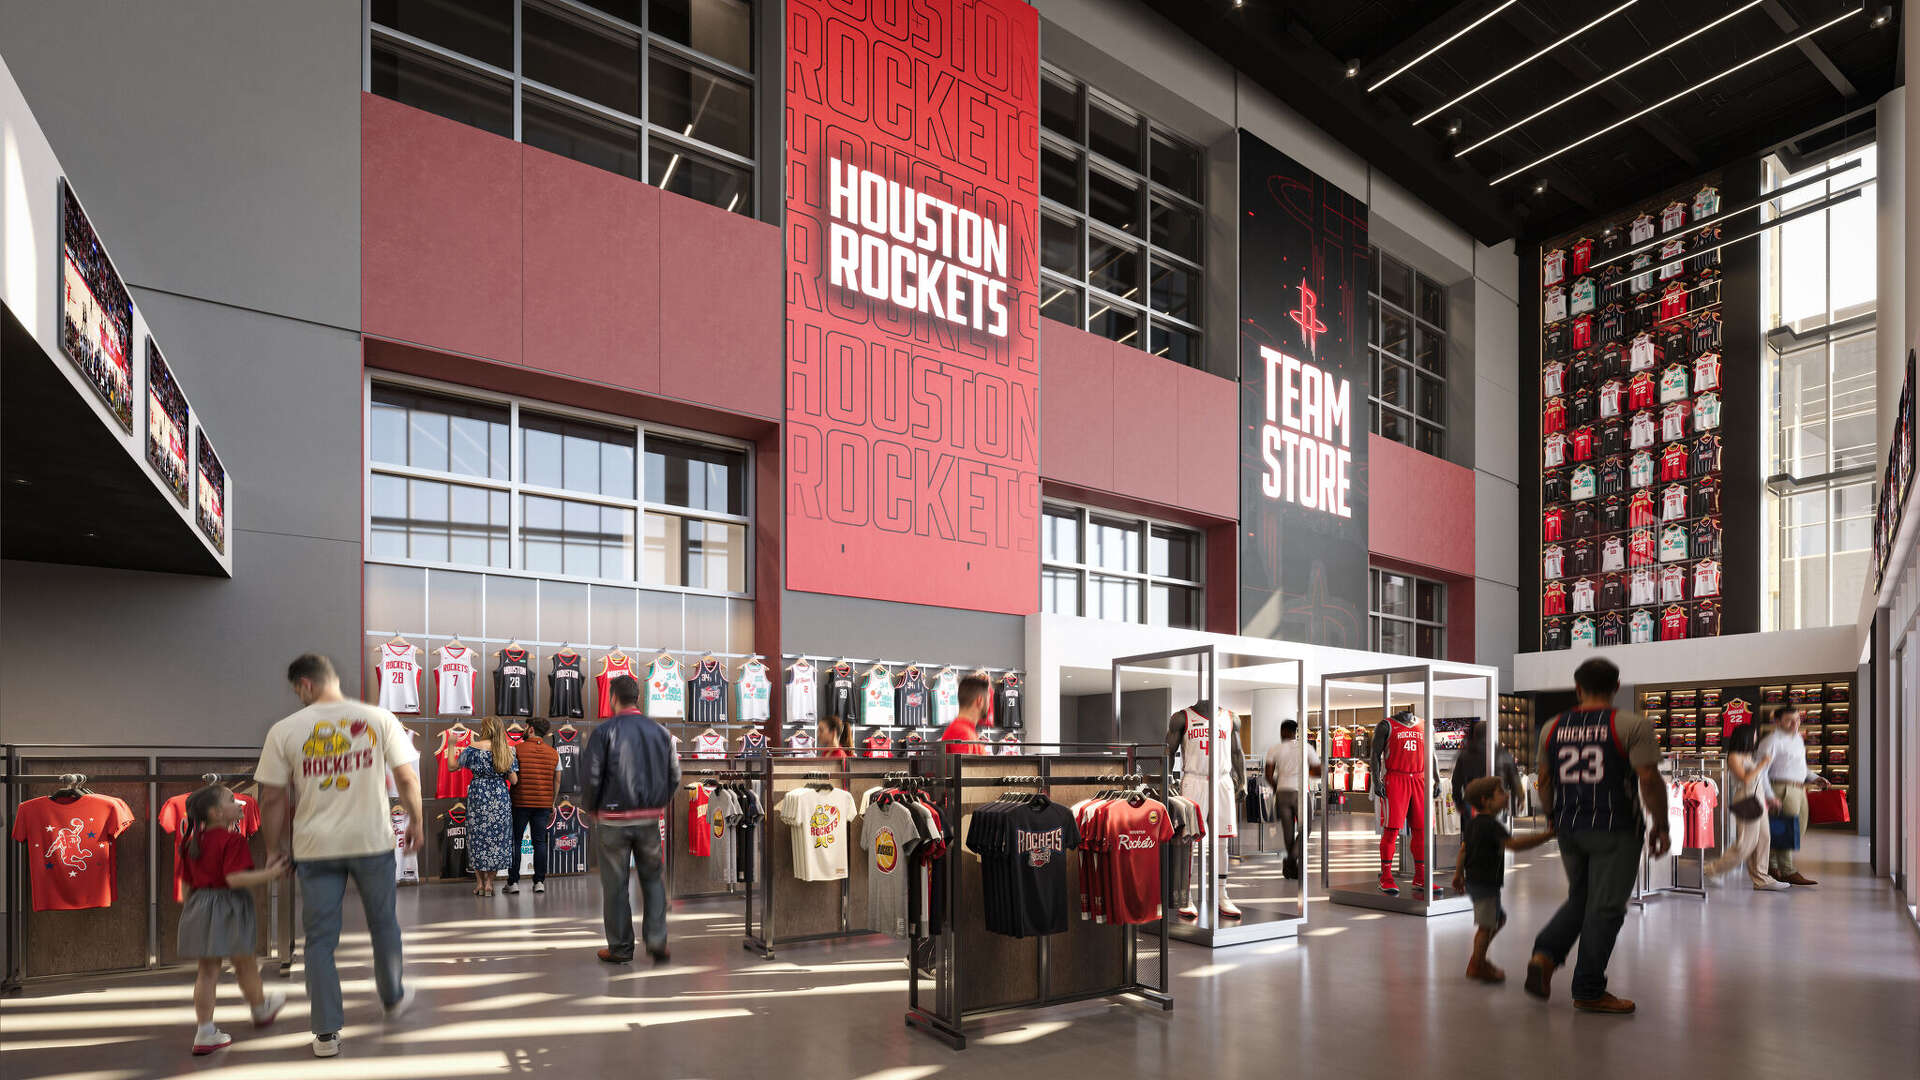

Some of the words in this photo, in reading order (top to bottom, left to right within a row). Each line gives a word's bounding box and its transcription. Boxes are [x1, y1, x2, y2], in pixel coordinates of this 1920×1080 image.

[786, 3, 1037, 197] ROCKETS
[830, 156, 1007, 278] HOUSTON
[830, 222, 1008, 338] ROCKETS
[786, 318, 1038, 466] HOUSTON
[1260, 345, 1350, 448] TEAM
[1261, 424, 1351, 519] STORE
[786, 420, 1038, 553] ROCKETS
[385, 660, 412, 672] ROCKETS
[443, 663, 468, 674] ROCKETS
[503, 665, 527, 676] HOUSTON
[392, 671, 404, 684] 28
[453, 674, 459, 687] 7
[556, 669, 579, 680] HOUSTON
[565, 679, 569, 690] 1
[1730, 714, 1743, 723] 22
[1188, 728, 1226, 740] HOUSN
[1397, 731, 1424, 740] ROCKETS
[1557, 725, 1608, 743] ROCKETS
[1404, 740, 1417, 751] 46
[302, 749, 374, 779] ROCKETS
[565, 756, 571, 768] 2
[1558, 745, 1604, 784] 23
[448, 826, 467, 837] HOUST
[454, 837, 465, 849] 30
[1018, 828, 1062, 855] ROCKETS
[1118, 834, 1155, 850] Rockets
